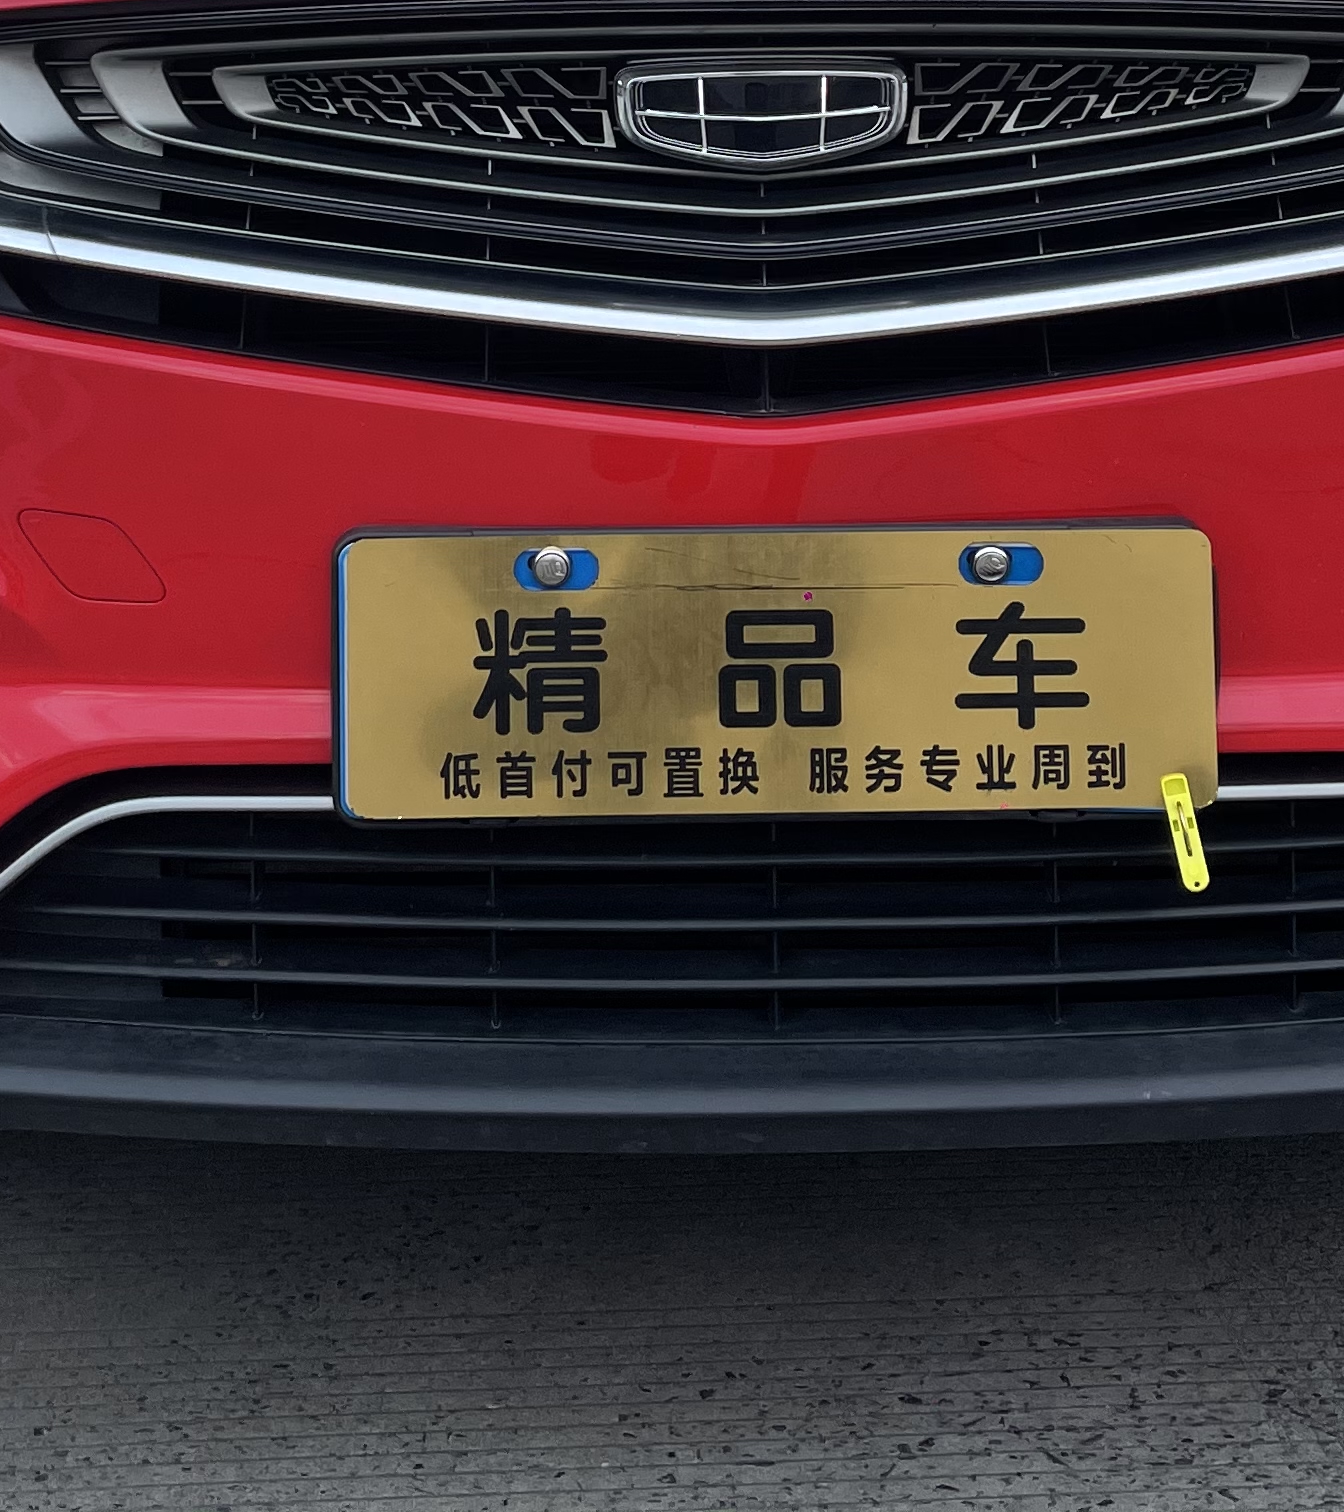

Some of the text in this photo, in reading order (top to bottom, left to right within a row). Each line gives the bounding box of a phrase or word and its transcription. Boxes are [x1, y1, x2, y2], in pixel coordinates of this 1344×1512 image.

[472, 601, 1091, 736] 精品车
[439, 742, 1128, 800] 低首付可置换 服务专业周到
